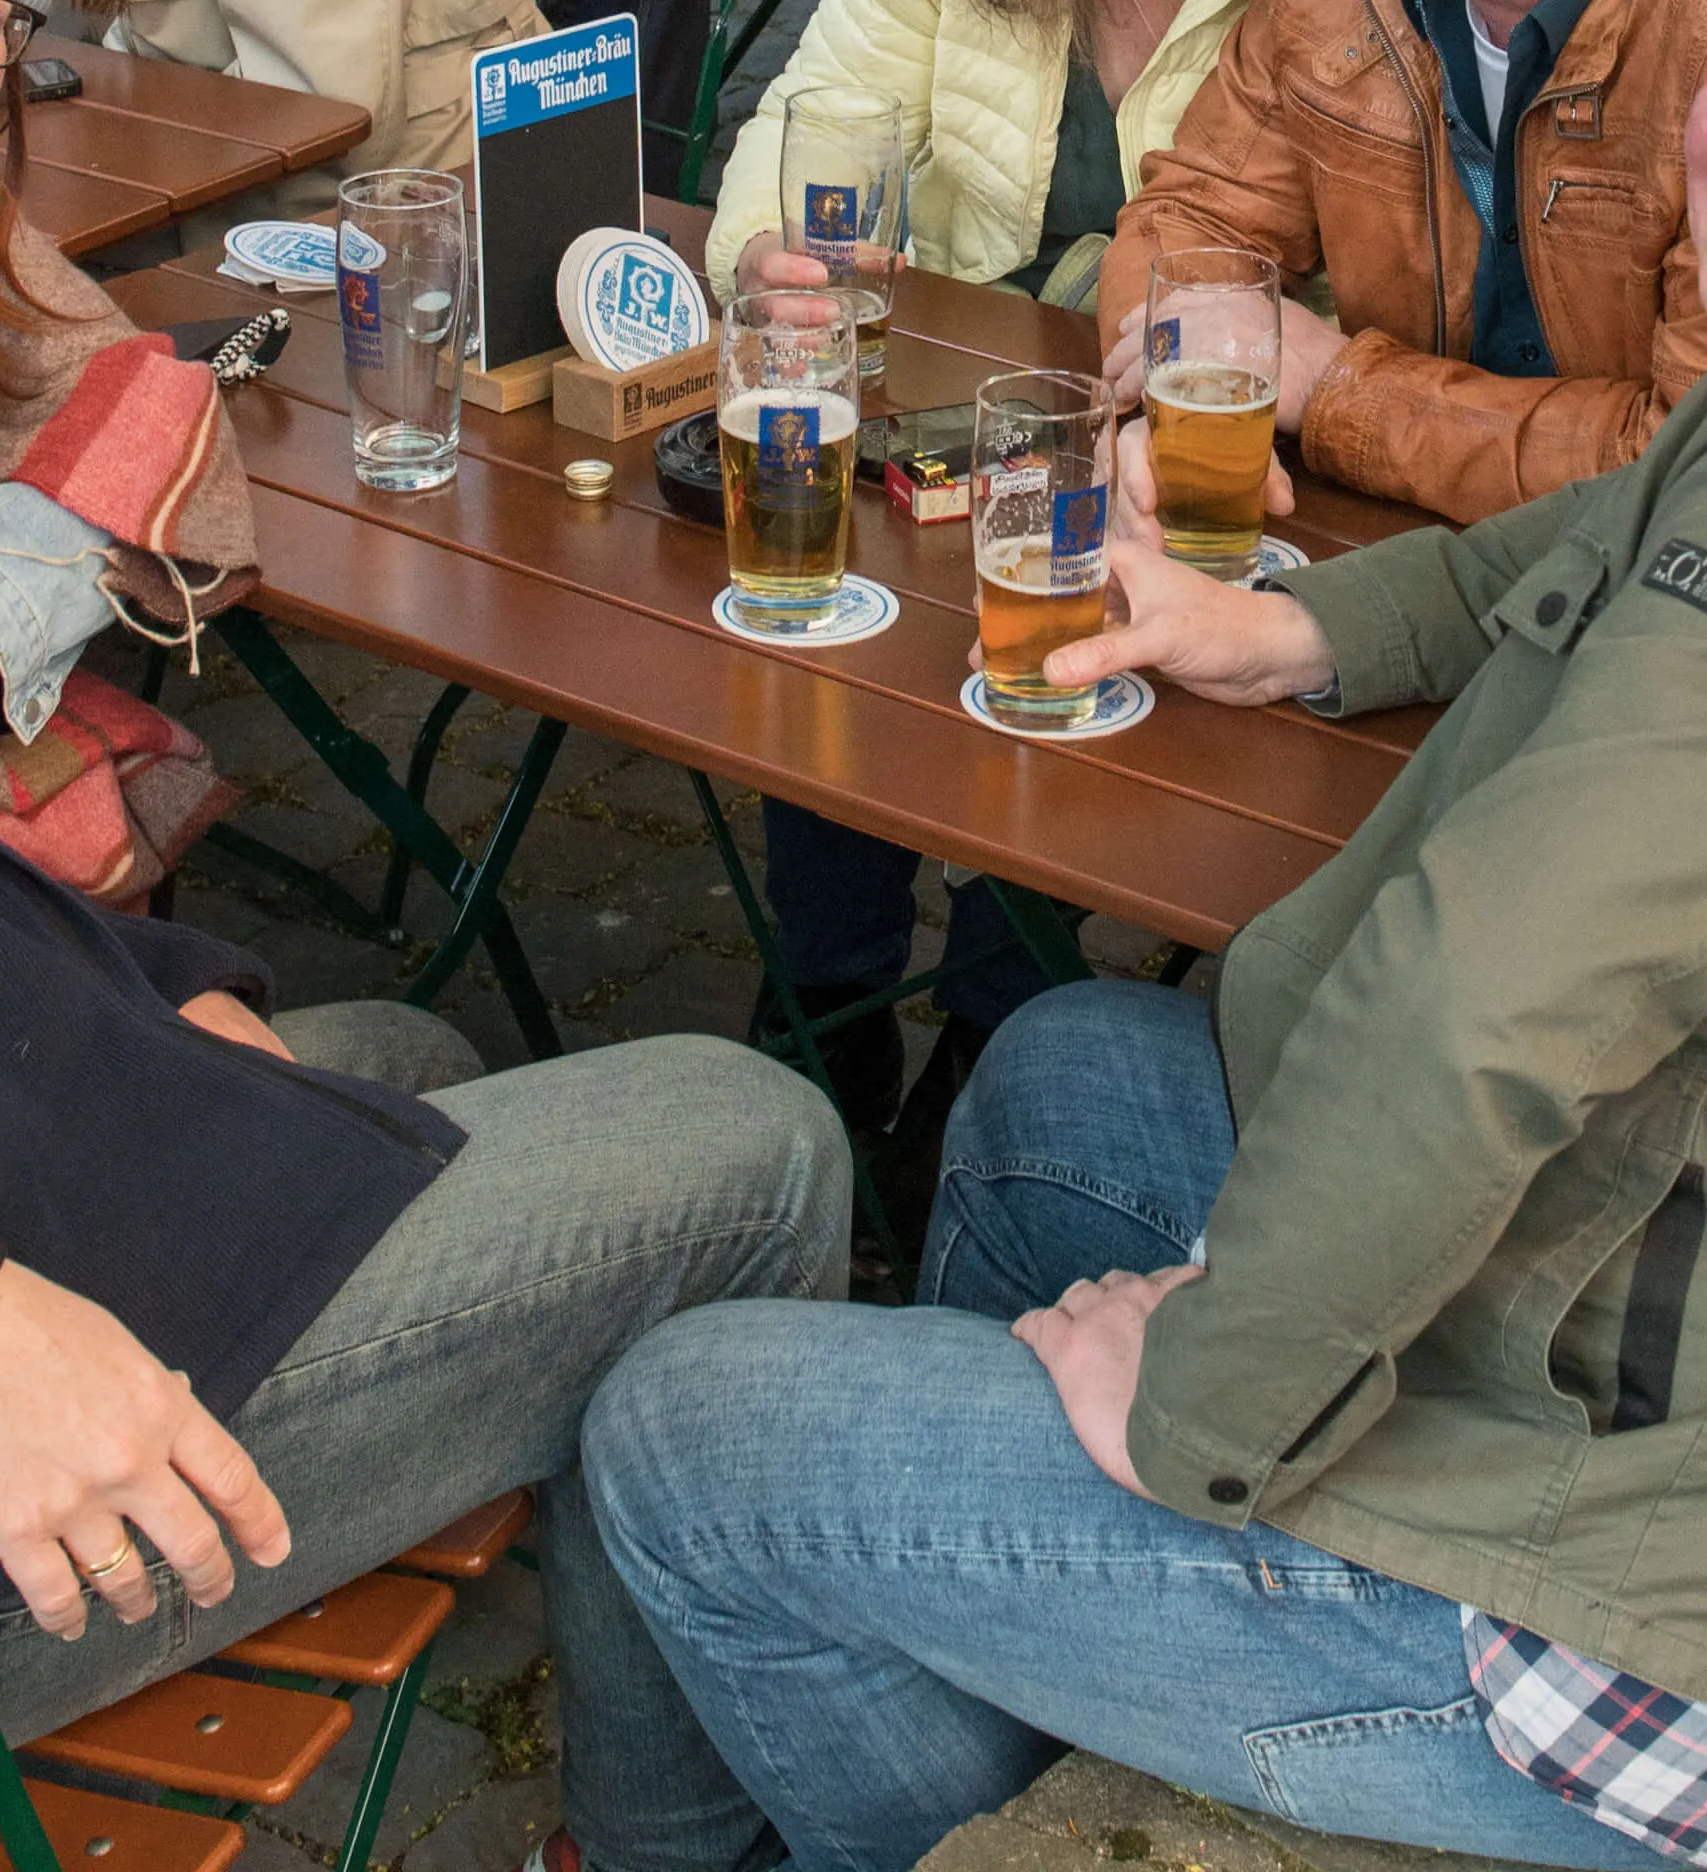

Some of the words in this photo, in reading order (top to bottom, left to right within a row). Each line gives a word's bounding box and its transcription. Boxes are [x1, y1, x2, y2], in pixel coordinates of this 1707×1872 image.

[537, 71, 608, 110] München
[624, 301, 639, 318] J.
[650, 310, 668, 331] W.
